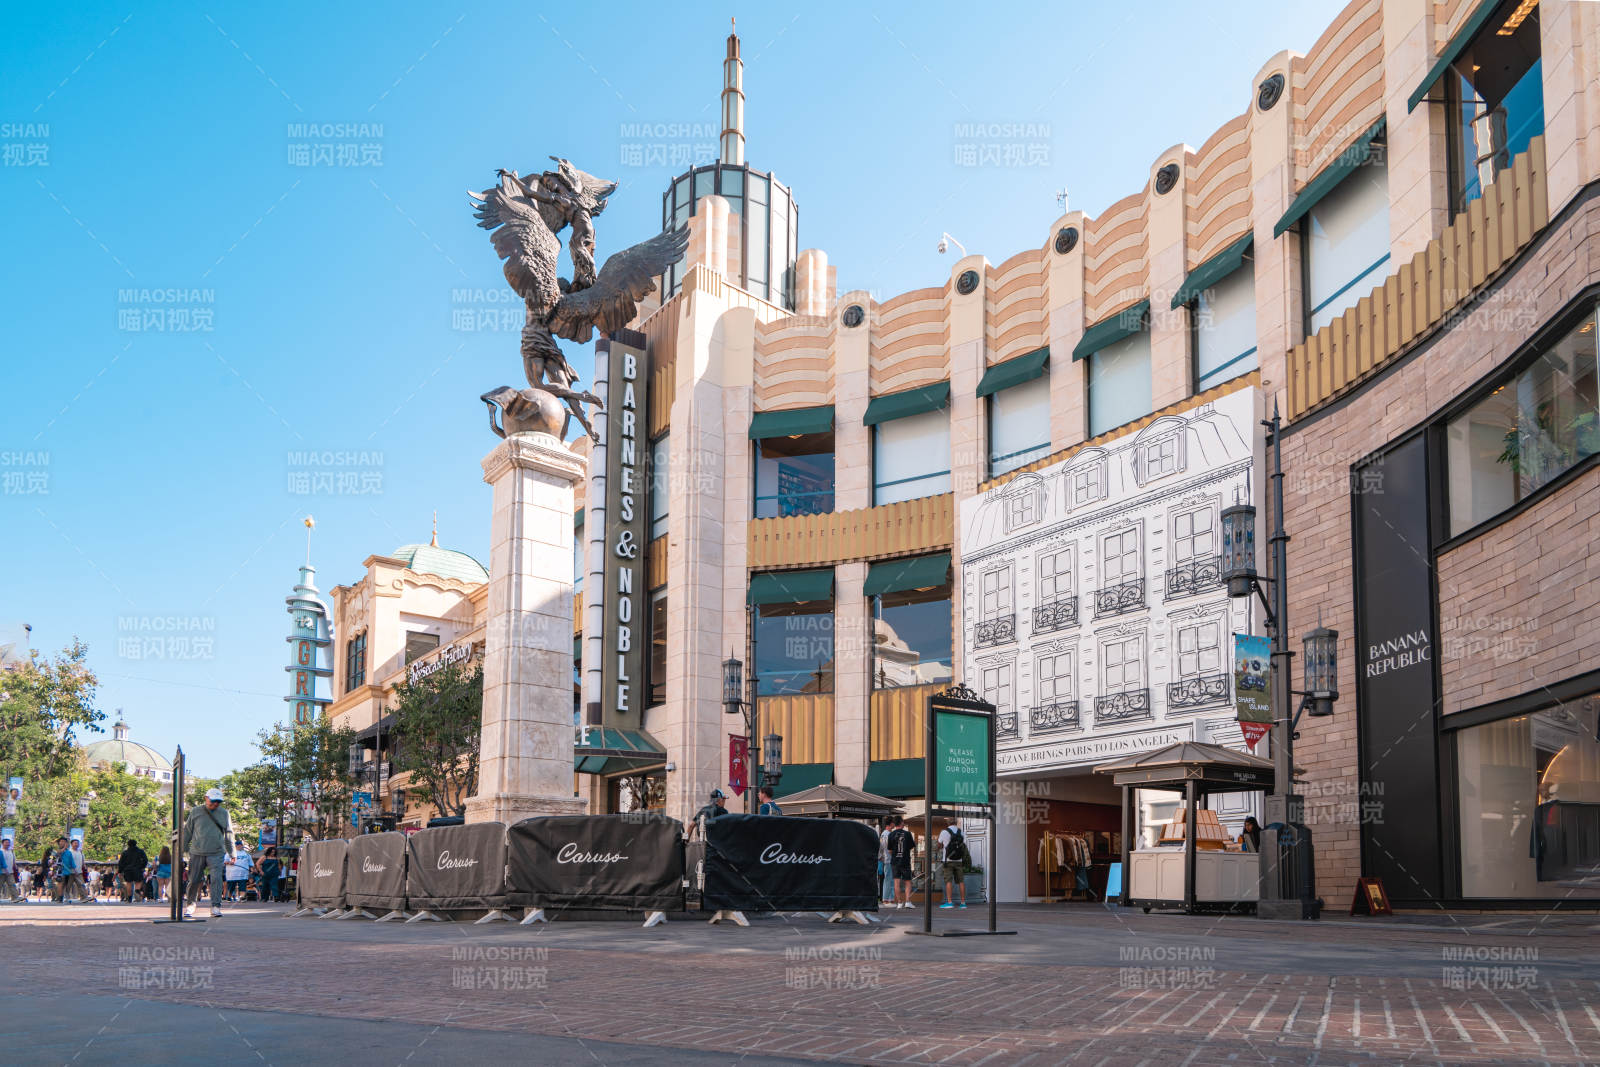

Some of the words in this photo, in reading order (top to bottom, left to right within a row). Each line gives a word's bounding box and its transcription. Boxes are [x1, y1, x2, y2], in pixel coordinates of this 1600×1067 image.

[622, 353, 637, 522] BARNES
[616, 530, 637, 558] &
[618, 566, 632, 711] NOBLE
[1370, 629, 1428, 660] BANANA
[442, 642, 472, 672] Factory
[1366, 645, 1430, 678] REPUBLIC
[296, 641, 310, 725] GRO
[950, 748, 974, 756] PLEASE
[997, 753, 1030, 764] SÉZANE
[1031, 750, 1064, 760] BRINGS
[1065, 745, 1093, 757] PARIS
[1095, 743, 1108, 752] TO
[1109, 740, 1128, 750] LOS
[1130, 733, 1178, 748] ANGELES
[362, 856, 386, 872] Caruso
[437, 850, 478, 870] Caruso
[556, 842, 628, 865] Caruso
[760, 842, 832, 865] Caruso
